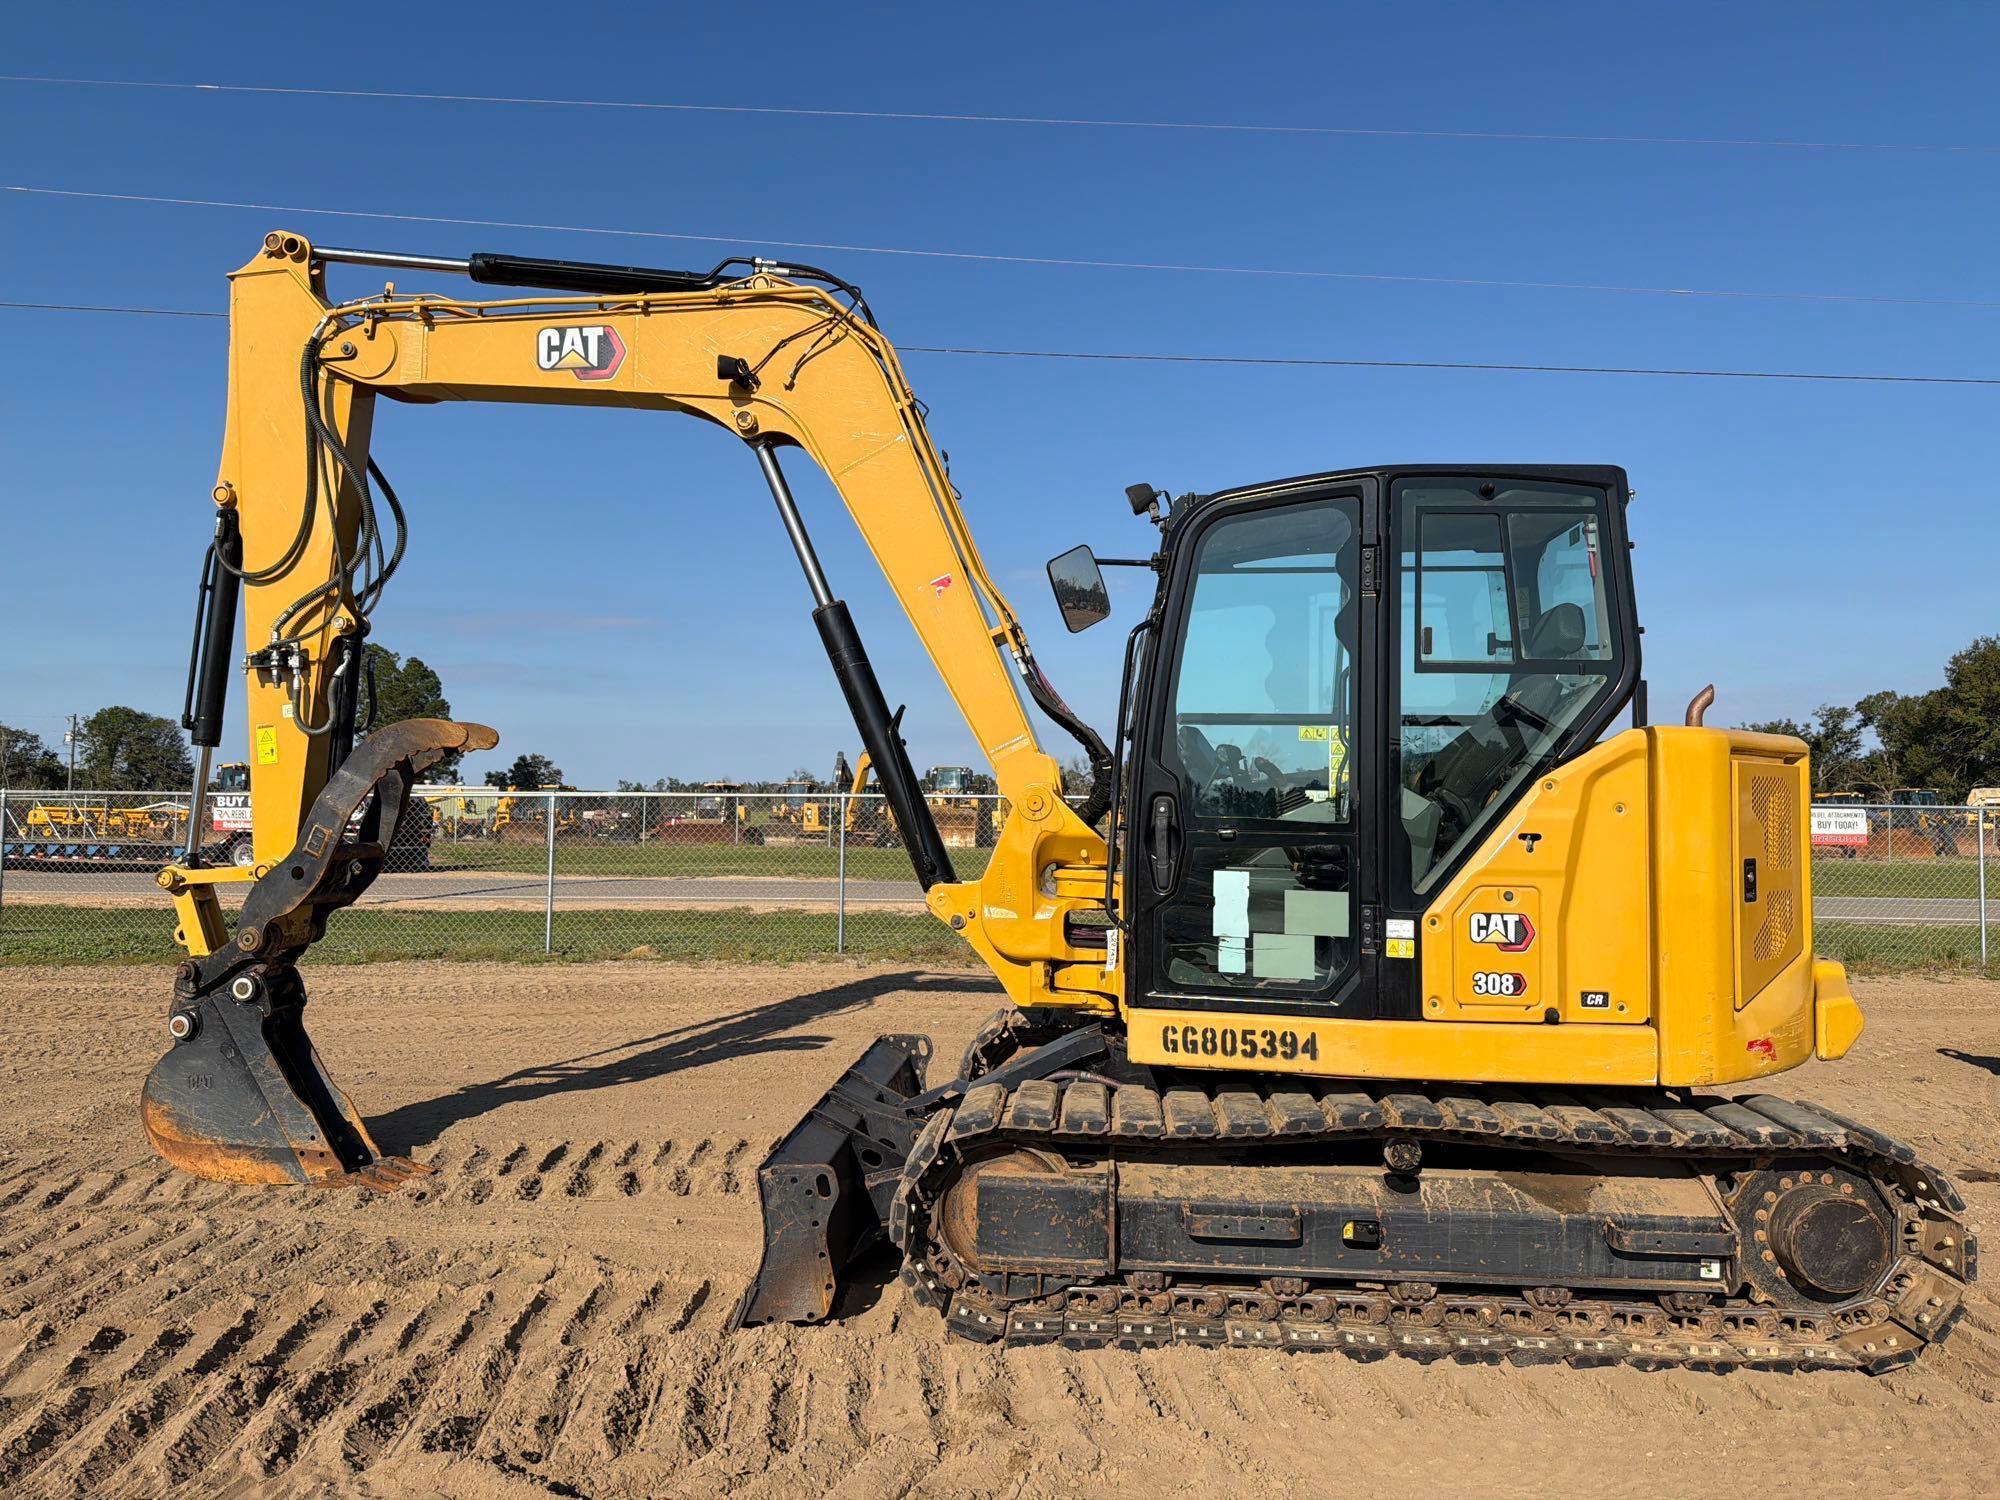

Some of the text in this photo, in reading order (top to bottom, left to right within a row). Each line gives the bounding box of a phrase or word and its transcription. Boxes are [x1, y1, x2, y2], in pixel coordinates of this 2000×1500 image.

[538, 326, 604, 369] CAT
[217, 796, 245, 807] BUY
[1817, 820, 1859, 830] BUY TODAY!
[1470, 913, 1520, 943] CAT
[1473, 972, 1514, 995] 308
[1586, 994, 1604, 1005] CR
[1162, 1025, 1318, 1061] GG805394
